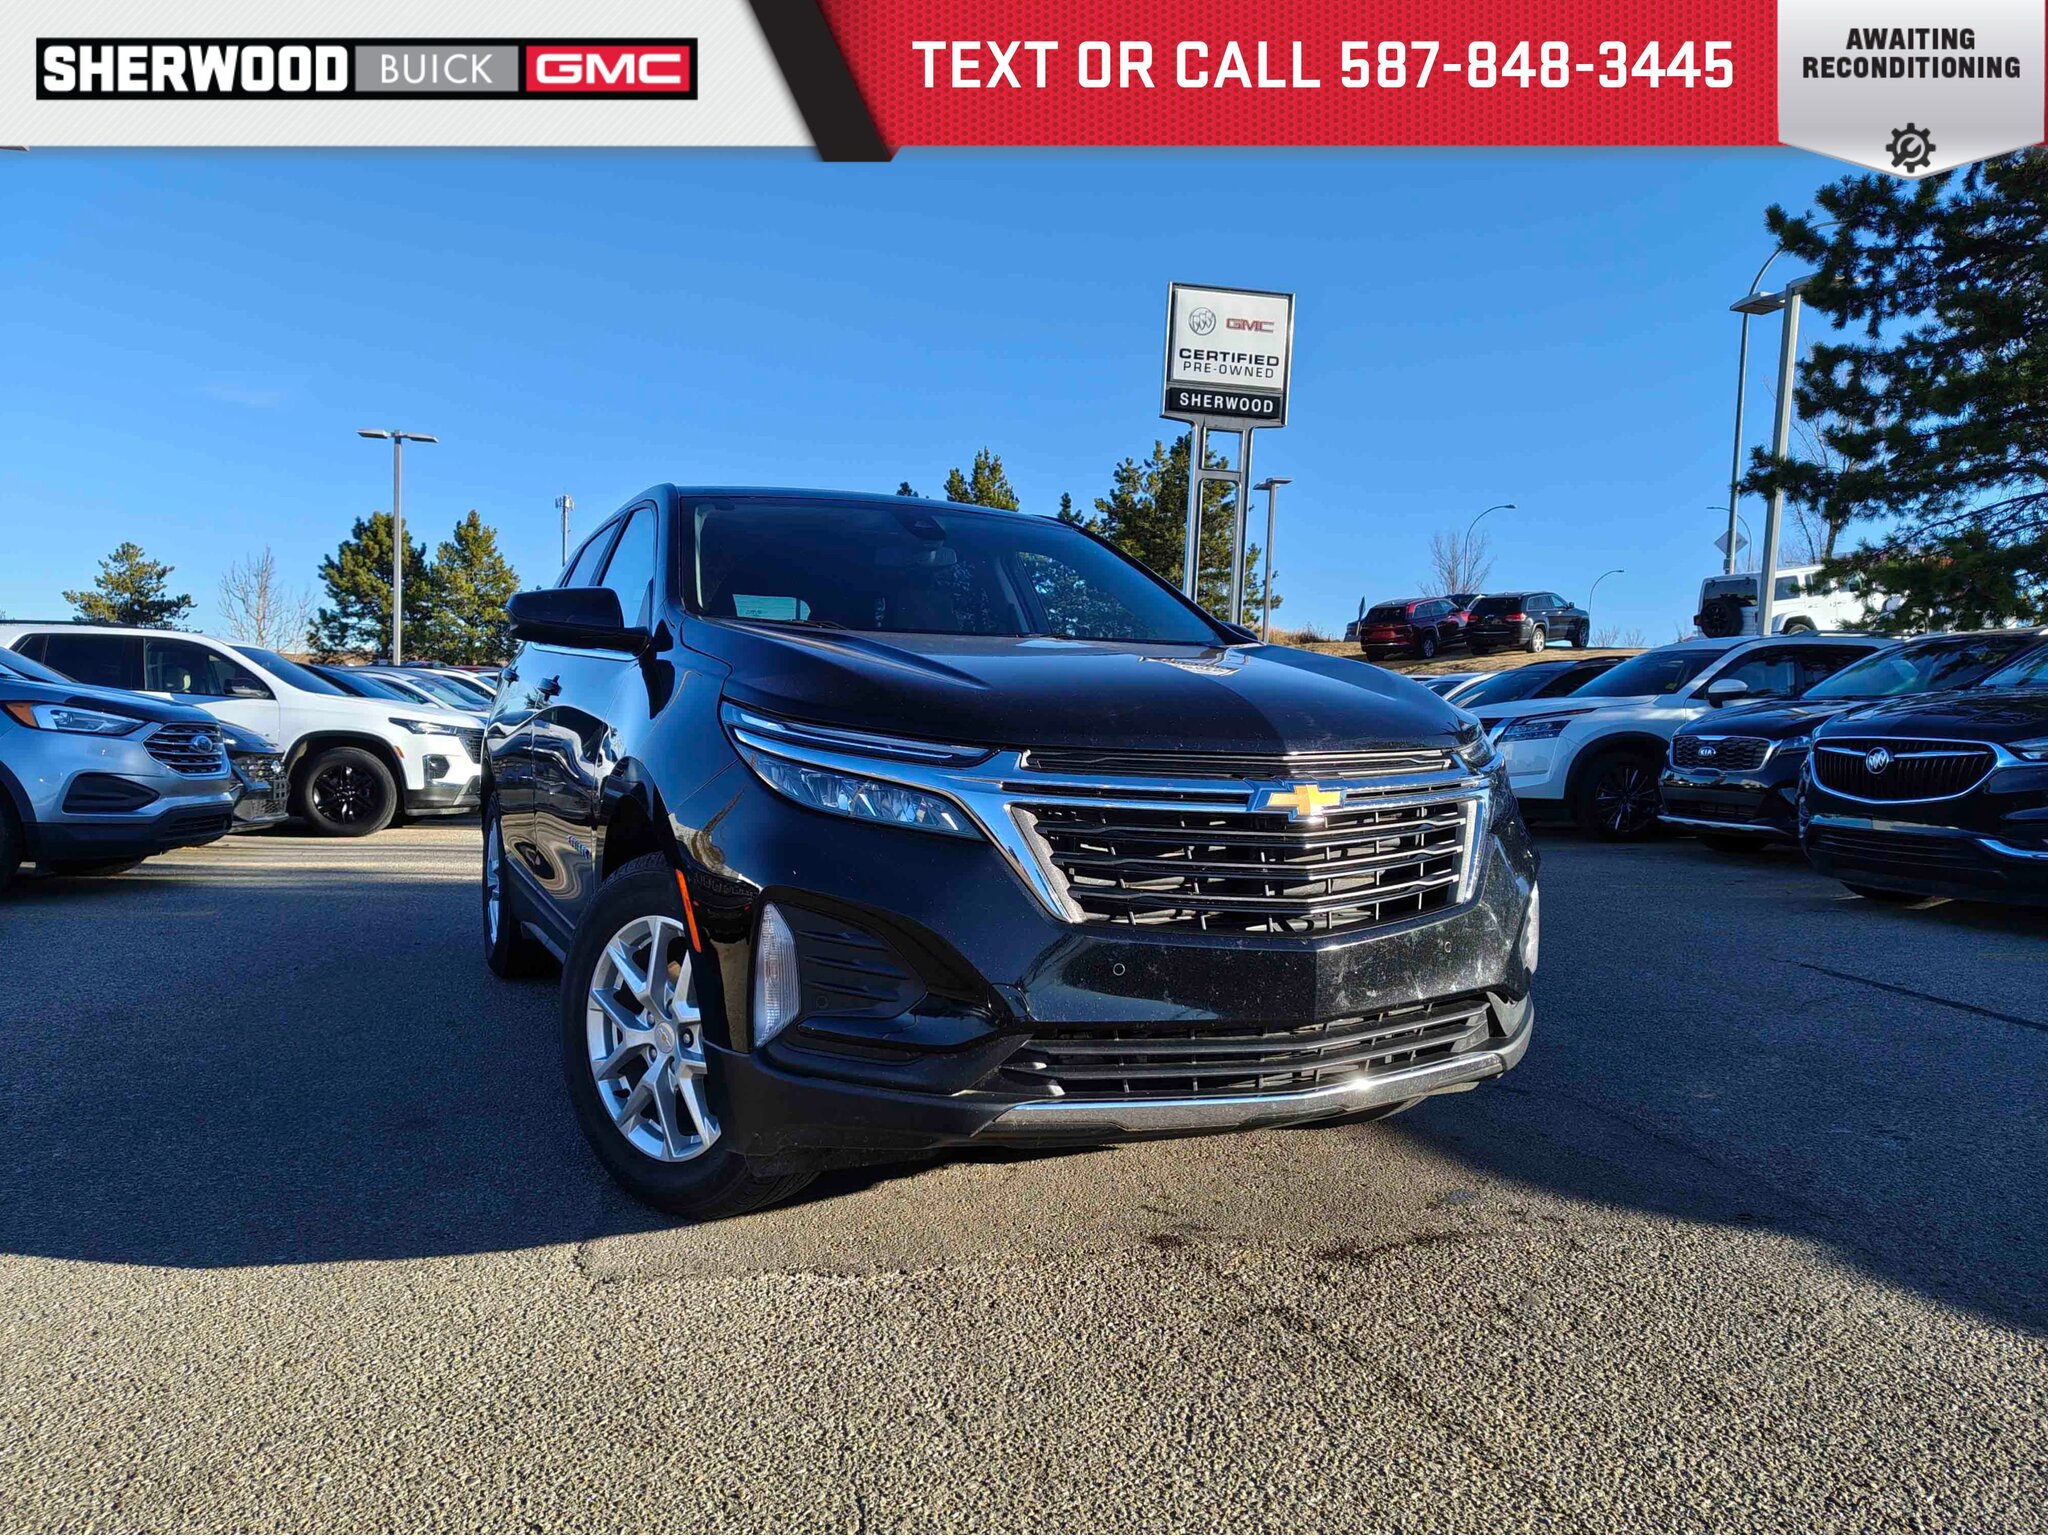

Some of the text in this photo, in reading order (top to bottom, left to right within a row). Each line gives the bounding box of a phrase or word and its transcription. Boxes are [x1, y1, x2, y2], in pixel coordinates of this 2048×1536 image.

[1226, 318, 1275, 333] GMC
[1179, 348, 1280, 367] CERTIFIED
[1183, 361, 1274, 378] PRE-OWNED
[1179, 392, 1274, 413] SHERWOOD
